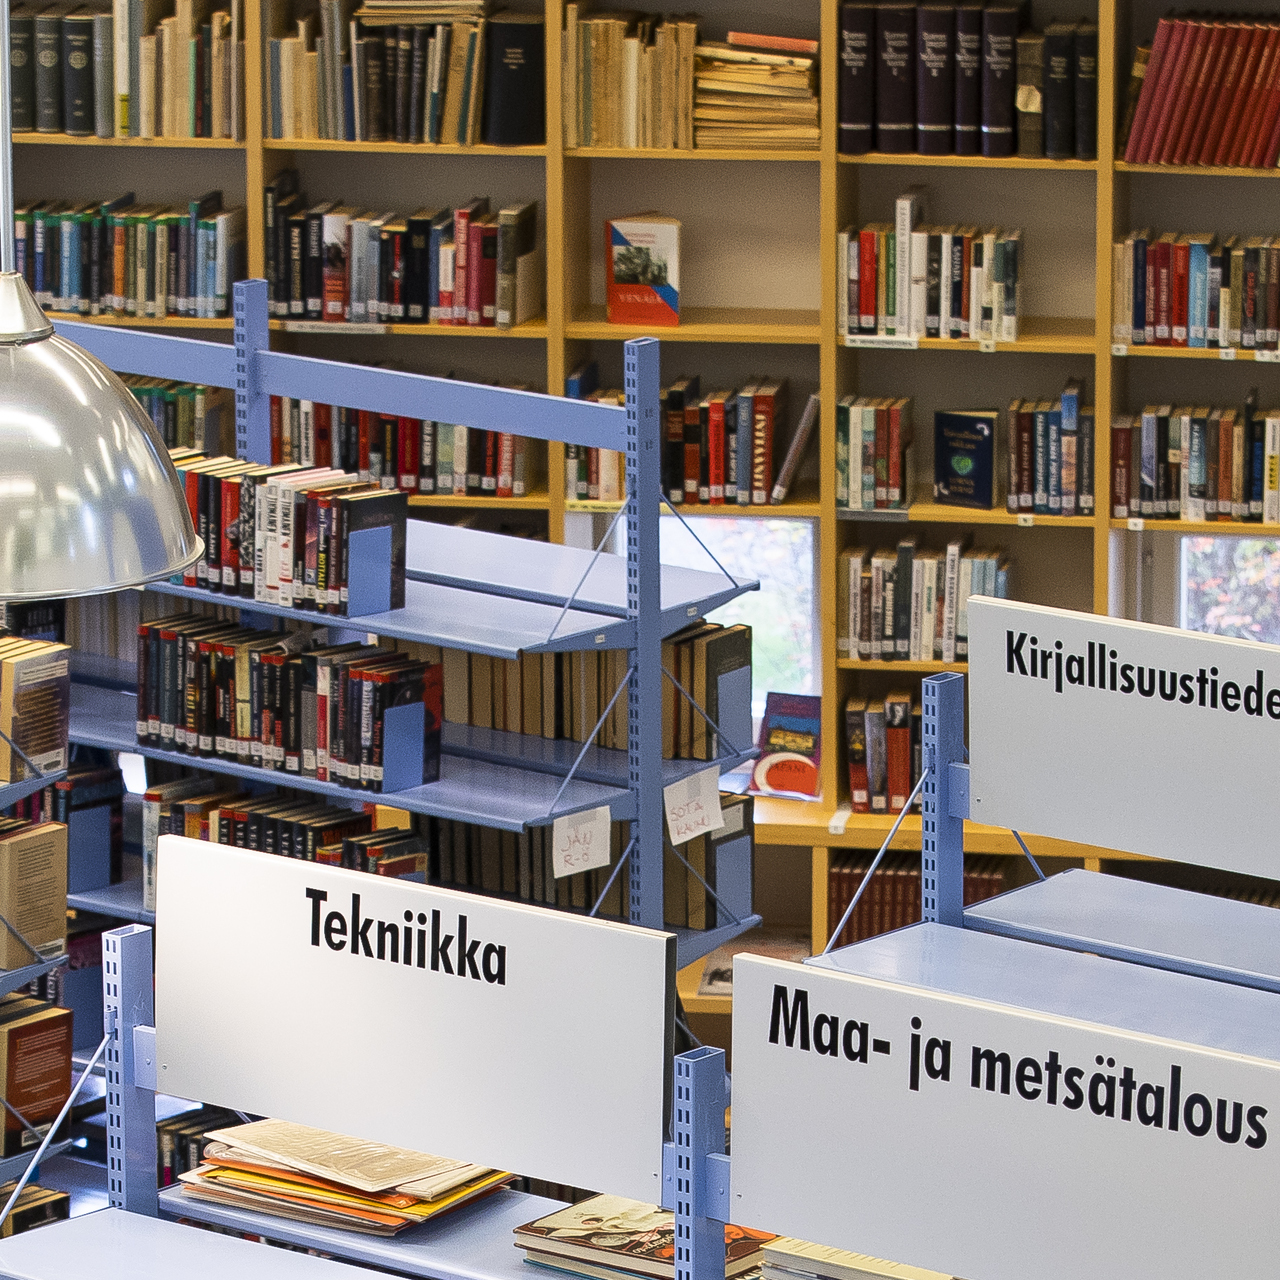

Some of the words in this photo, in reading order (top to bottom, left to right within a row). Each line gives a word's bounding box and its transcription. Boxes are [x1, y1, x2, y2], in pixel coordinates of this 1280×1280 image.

[306, 886, 507, 986] Tekniikka
[769, 984, 891, 1064] Maa-
[909, 1016, 951, 1092] ja
[971, 1046, 1268, 1149] metsätalous
